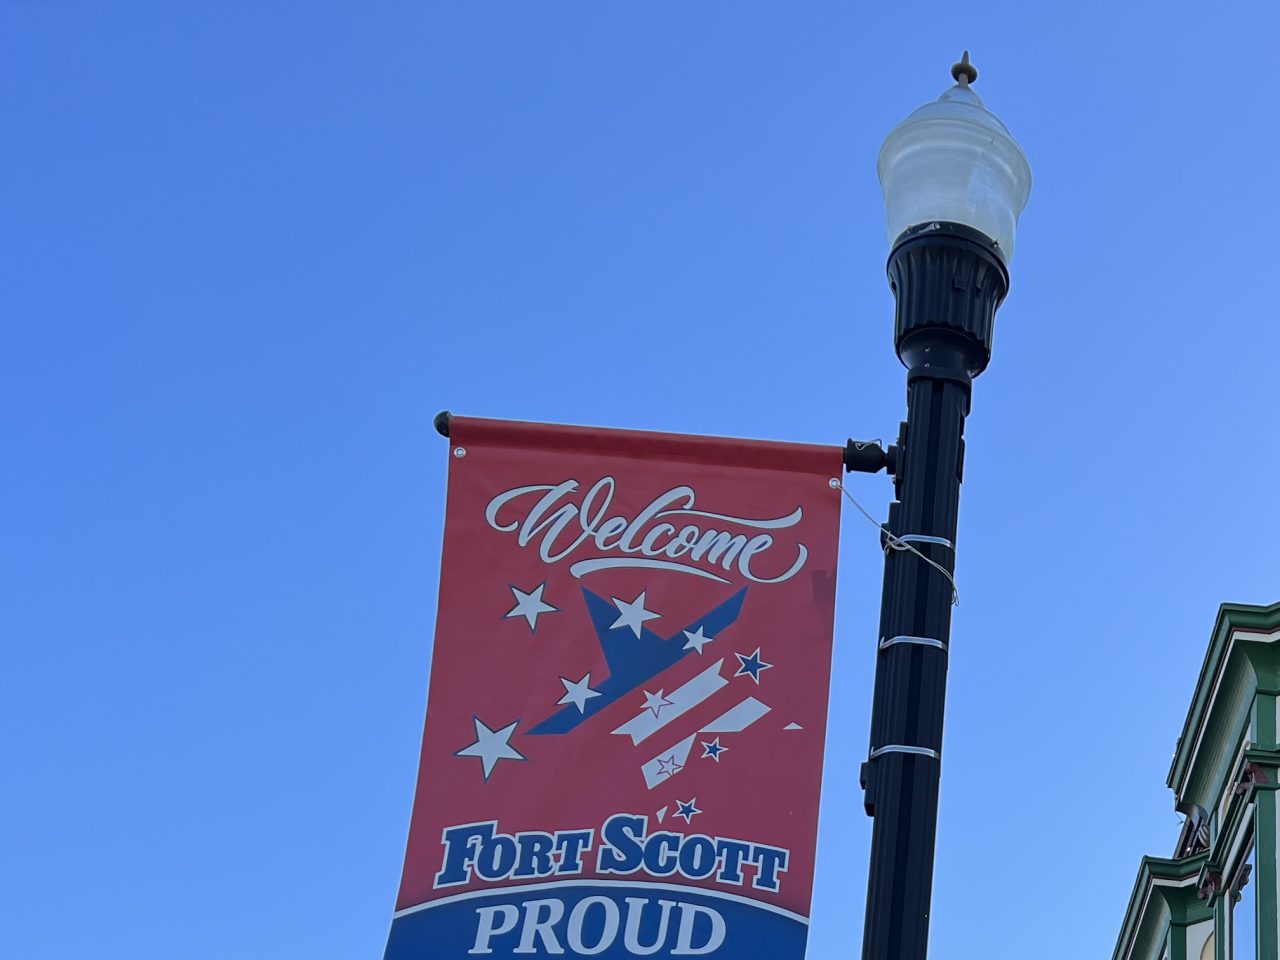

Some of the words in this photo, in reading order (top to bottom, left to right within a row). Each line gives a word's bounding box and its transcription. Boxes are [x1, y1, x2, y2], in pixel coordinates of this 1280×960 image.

[485, 475, 809, 585] Welcome
[432, 820, 595, 890] FORT
[595, 812, 791, 893] SCOTT
[467, 895, 727, 956] PROUD
